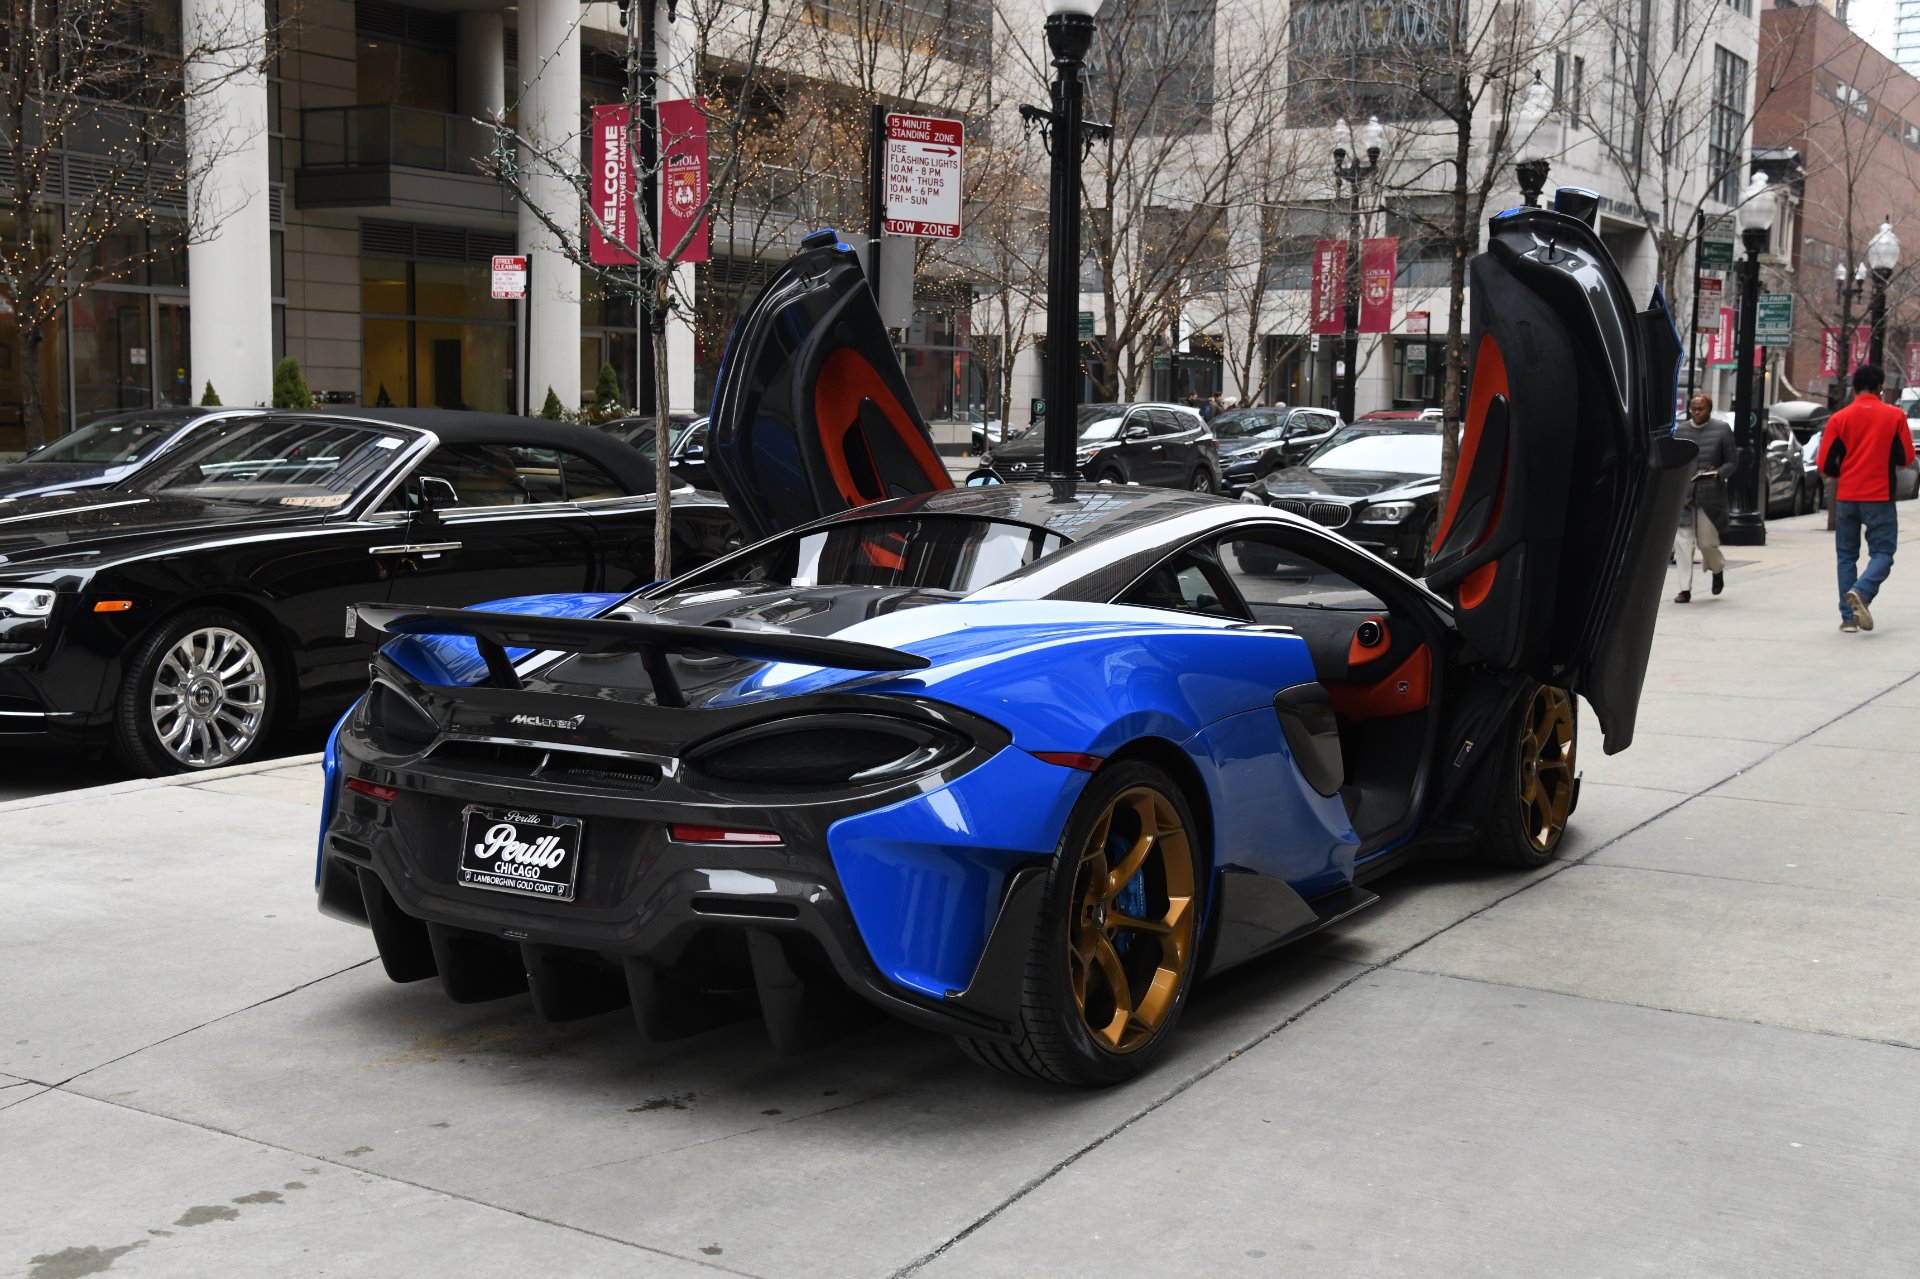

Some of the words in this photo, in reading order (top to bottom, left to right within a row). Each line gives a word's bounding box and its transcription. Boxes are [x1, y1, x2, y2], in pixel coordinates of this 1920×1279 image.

[892, 117, 900, 127] 15
[902, 119, 932, 130] MINUTE
[891, 129, 930, 140] STANDING
[934, 132, 955, 143] ZONE
[619, 125, 628, 171] CAMPUS
[891, 144, 907, 153] USE
[890, 154, 930, 166] FLASHING
[931, 158, 958, 169] LIGHTS
[890, 164, 899, 173] 10
[900, 165, 913, 174] AM
[928, 168, 941, 177] PM
[603, 125, 619, 244] WELCOME
[890, 174, 908, 184] MON
[918, 176, 945, 187] THURS
[619, 172, 627, 209] TOWER
[890, 184, 899, 193] 10
[899, 185, 912, 194] AM
[927, 187, 940, 197] PM
[889, 194, 903, 204] FRI
[911, 195, 928, 206] SUN
[618, 210, 627, 244] WATER
[889, 220, 915, 233] TOW
[921, 223, 954, 237] ZONE
[504, 810, 541, 824] Perillo
[474, 823, 566, 869] Perillo
[494, 861, 540, 879] CHICAGO
[473, 873, 516, 888] LAMBORGHINI
[516, 880, 534, 890] GOLD
[534, 883, 555, 894] COAST
